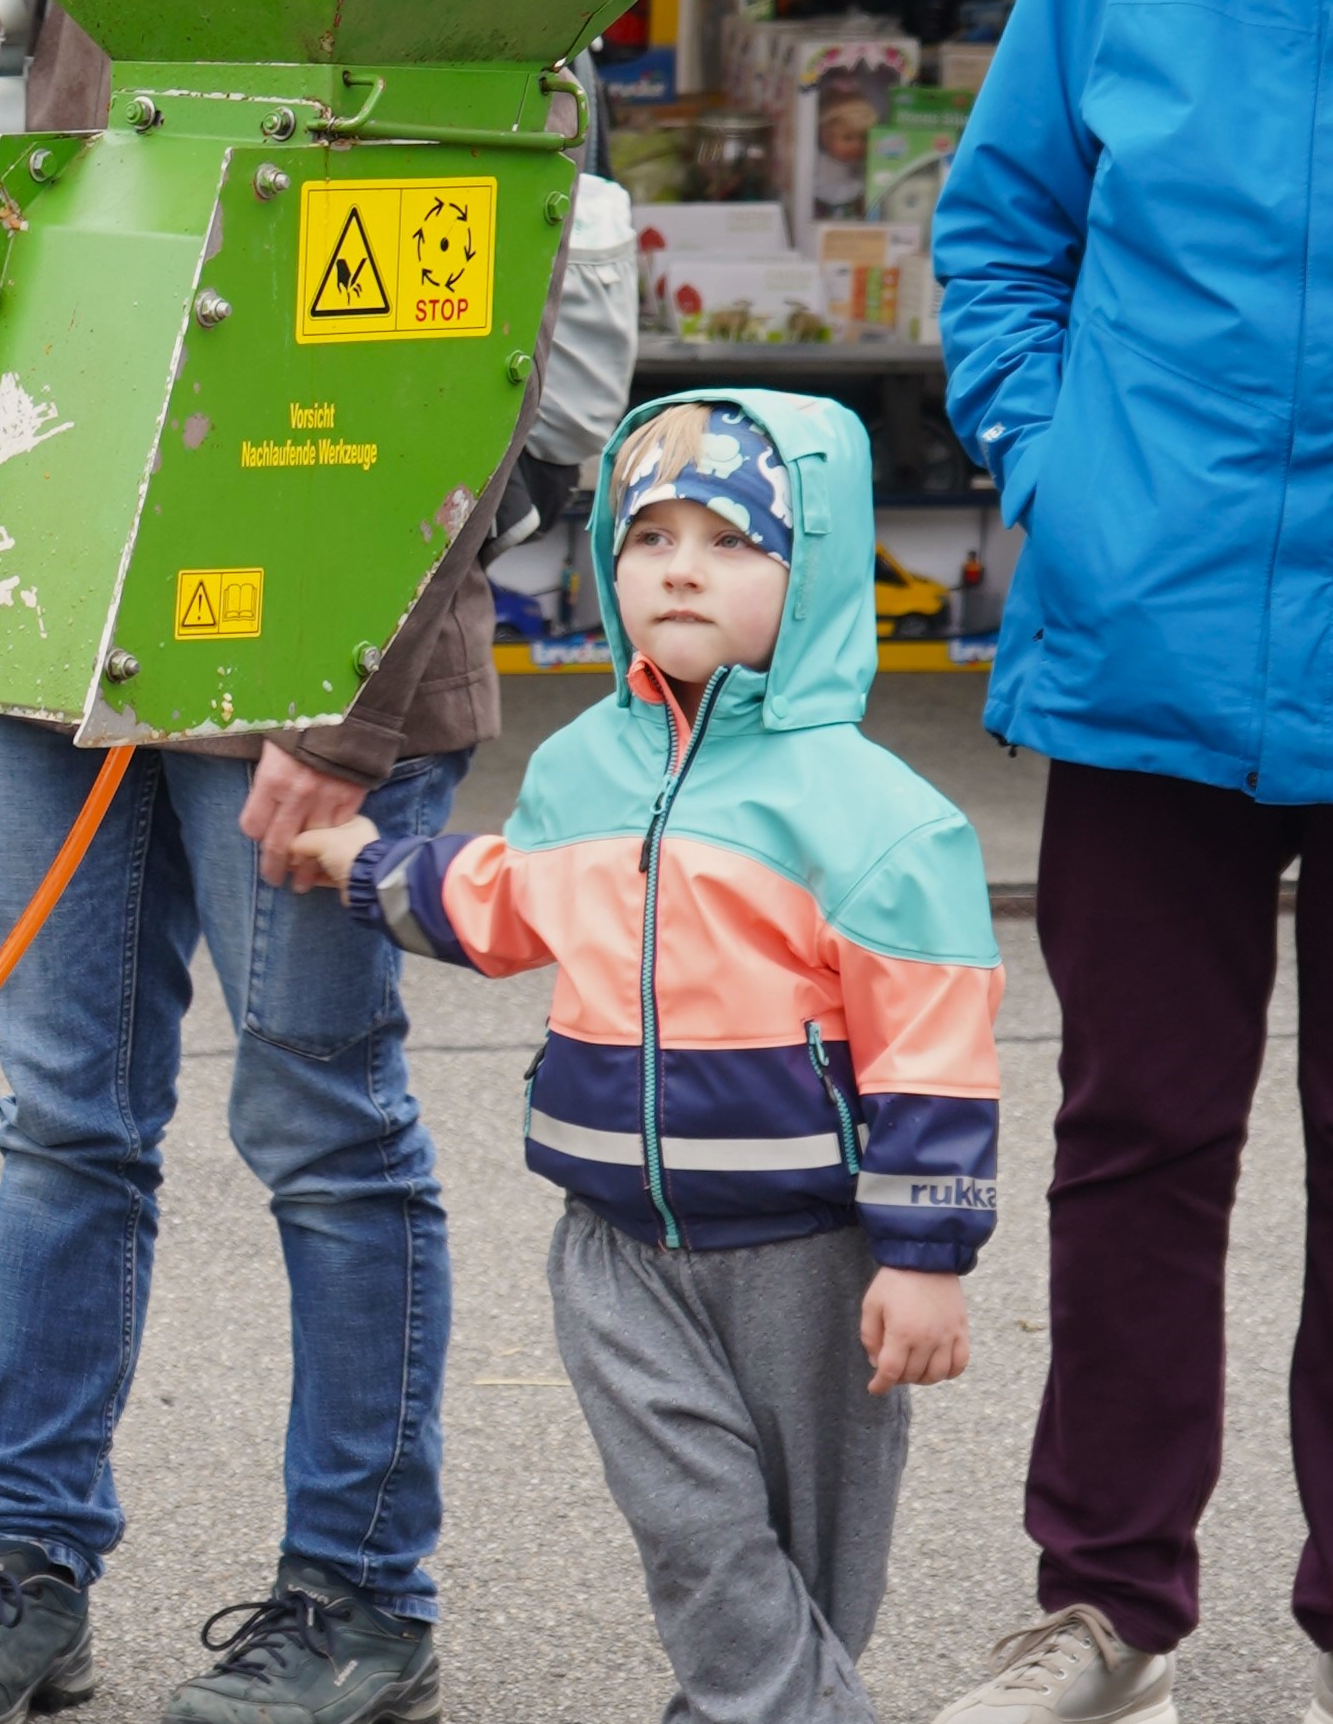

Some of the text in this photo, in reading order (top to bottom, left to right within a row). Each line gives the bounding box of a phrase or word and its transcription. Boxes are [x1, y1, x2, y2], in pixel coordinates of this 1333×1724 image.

[415, 298, 469, 322] STOP
[290, 402, 336, 429] Vorsicht
[241, 438, 378, 471] Nachlaufende Werkzeuge
[910, 1178, 997, 1209] rukka
